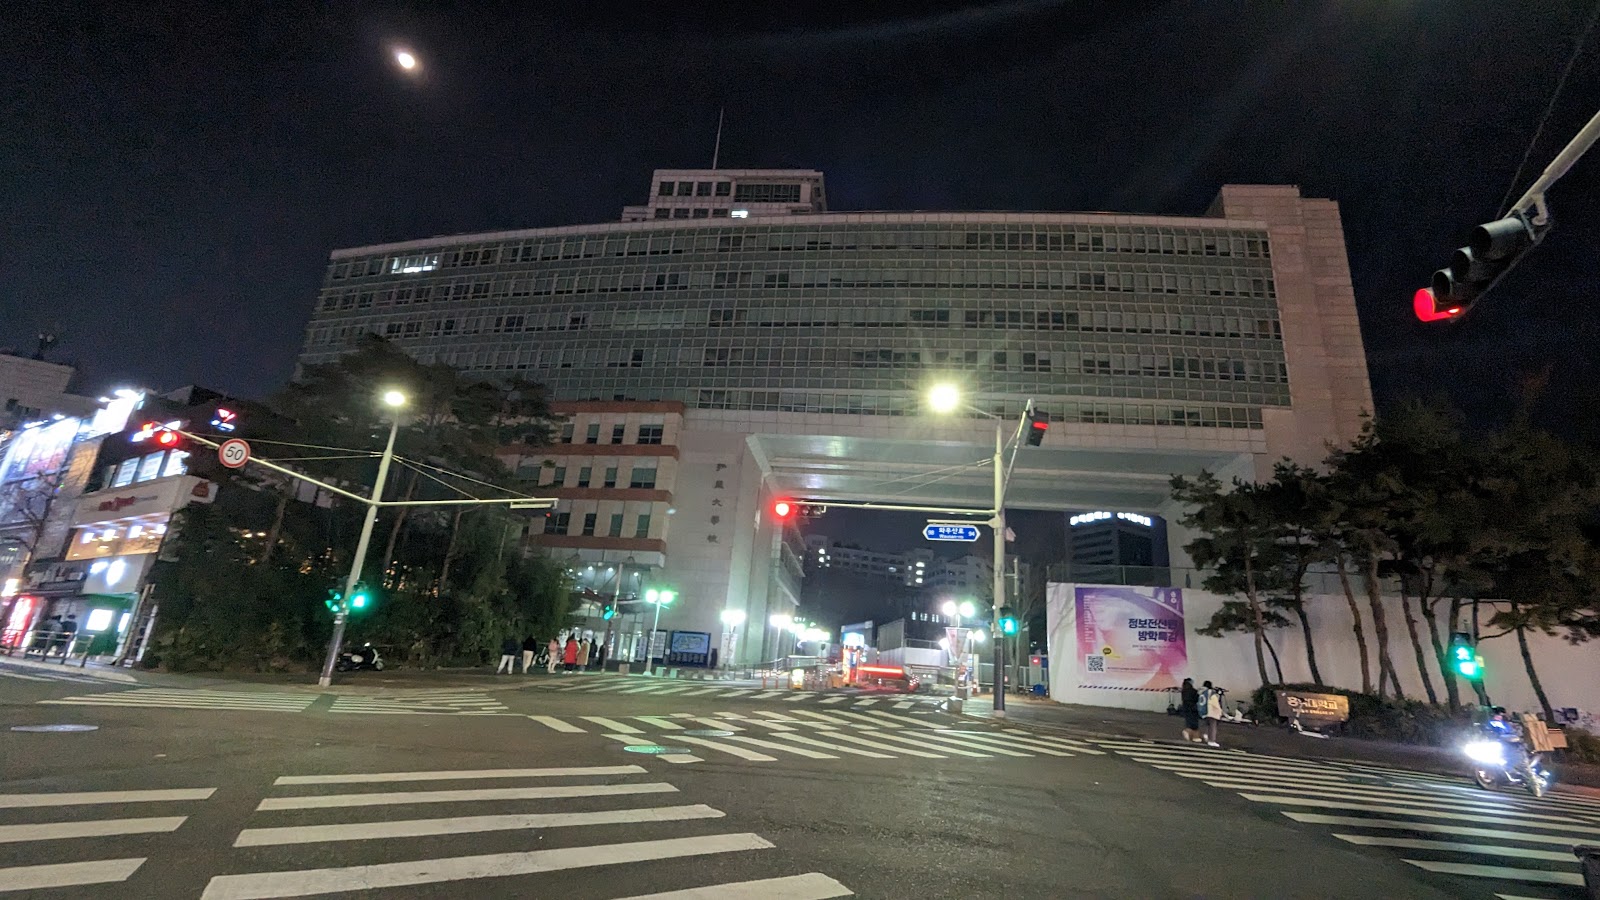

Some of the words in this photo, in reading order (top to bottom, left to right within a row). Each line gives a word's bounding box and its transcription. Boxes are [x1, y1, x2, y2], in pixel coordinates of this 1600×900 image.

[225, 446, 244, 461] 50
[938, 527, 965, 535] 와우산로
[1138, 630, 1177, 643] 방학특강
